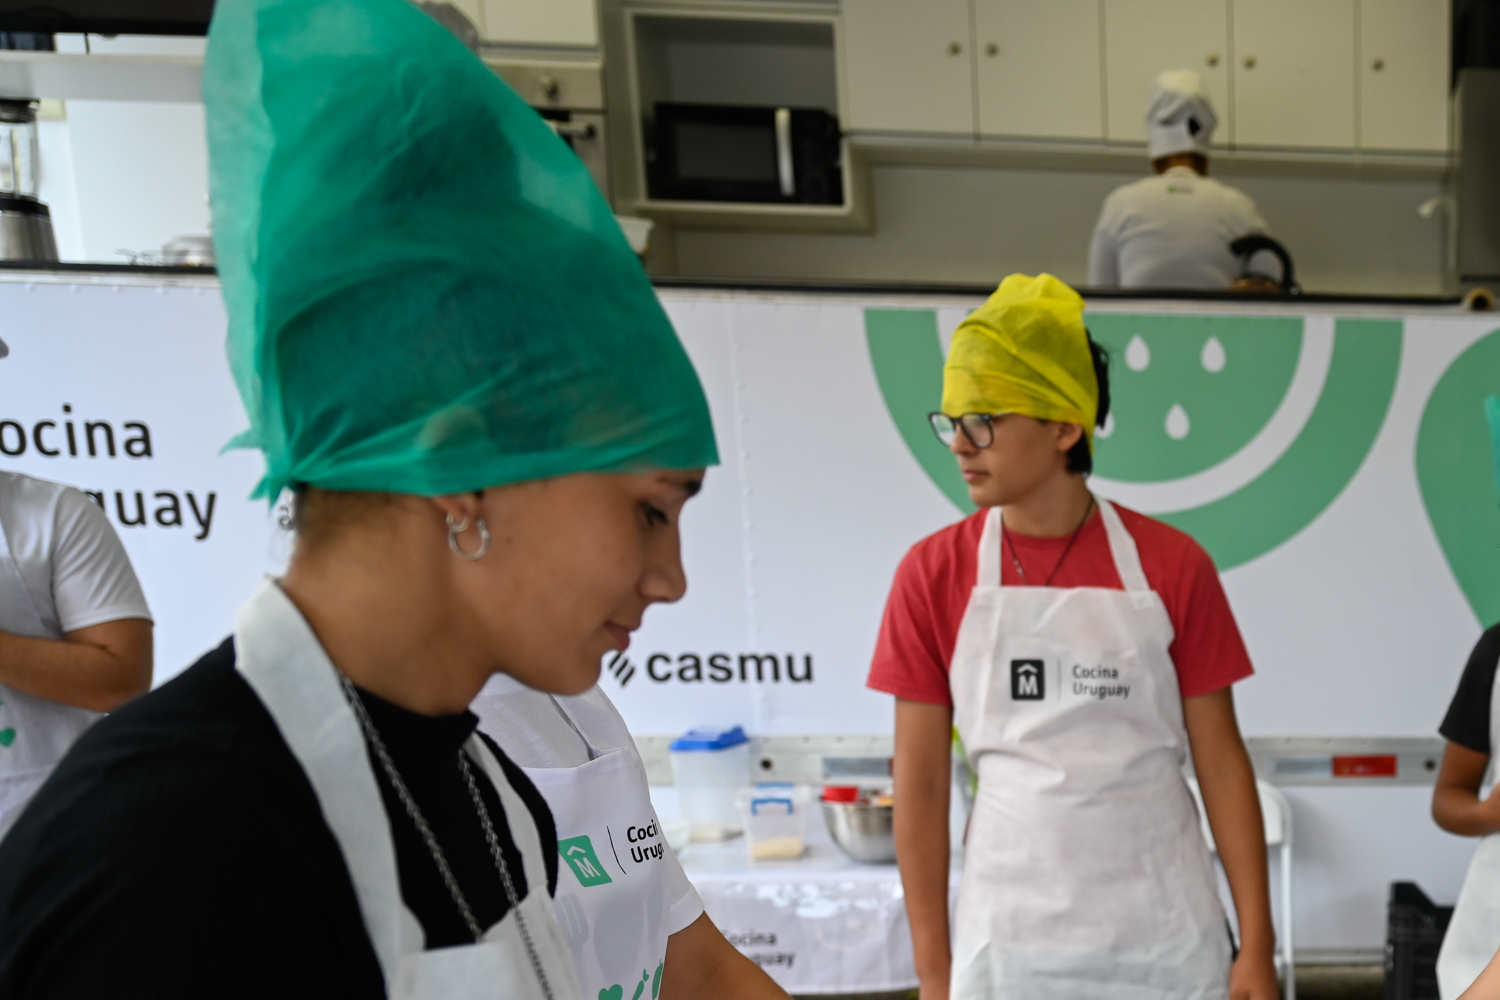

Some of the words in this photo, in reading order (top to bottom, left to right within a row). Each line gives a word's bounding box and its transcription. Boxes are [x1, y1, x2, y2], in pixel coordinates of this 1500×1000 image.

[646, 652, 814, 693] casmu
[1072, 663, 1119, 680] Cocina
[1073, 681, 1131, 700] Uruguay
